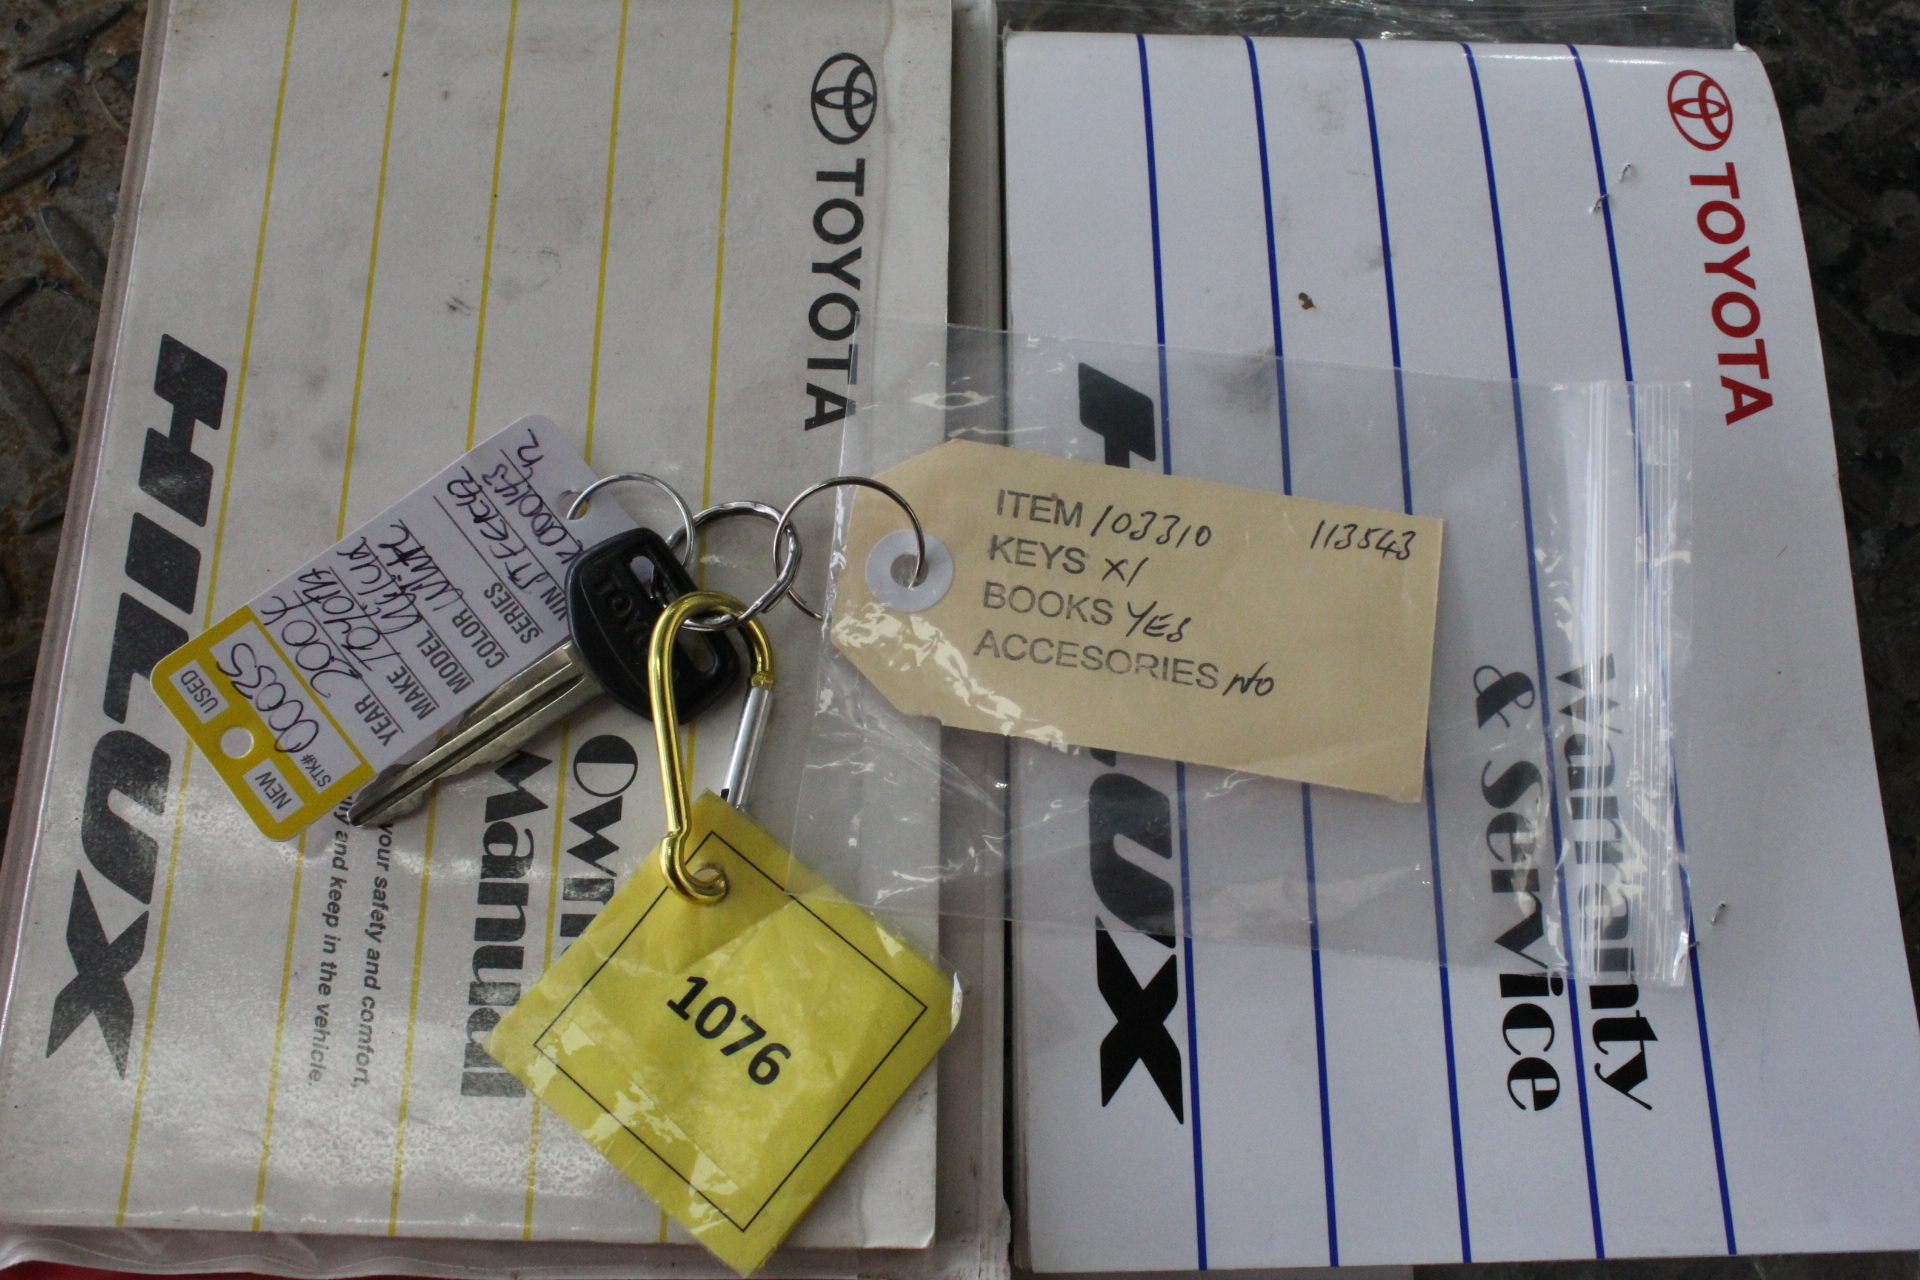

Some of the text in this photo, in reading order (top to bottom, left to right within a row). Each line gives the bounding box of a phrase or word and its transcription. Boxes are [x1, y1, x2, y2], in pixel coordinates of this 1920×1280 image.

[804, 158, 866, 431] TOYOTA
[1689, 162, 1774, 426] TOYOTA
[995, 489, 1212, 550] ITEM 103310
[988, 534, 1088, 575] KEYS
[451, 607, 507, 669] COLOR
[483, 582, 541, 645] SERIES
[982, 580, 1192, 643] BOOKS YES
[261, 595, 399, 747] YEAR 2004
[416, 630, 472, 695] MODEL
[973, 629, 1220, 690] ACCESORIES
[180, 669, 219, 714] USED
[386, 666, 437, 721] MAKE
[255, 771, 292, 810] NEW
[300, 753, 332, 787] STK#
[331, 829, 350, 871] and
[322, 875, 348, 929] keep
[1473, 665, 1564, 1111] & Service
[1555, 653, 1658, 1110] Warranty
[322, 933, 342, 956] in
[350, 822, 394, 1090] your safety and comfort,
[317, 961, 338, 997] the
[308, 1002, 331, 1087] vehicle.
[666, 976, 793, 1086] 1076
